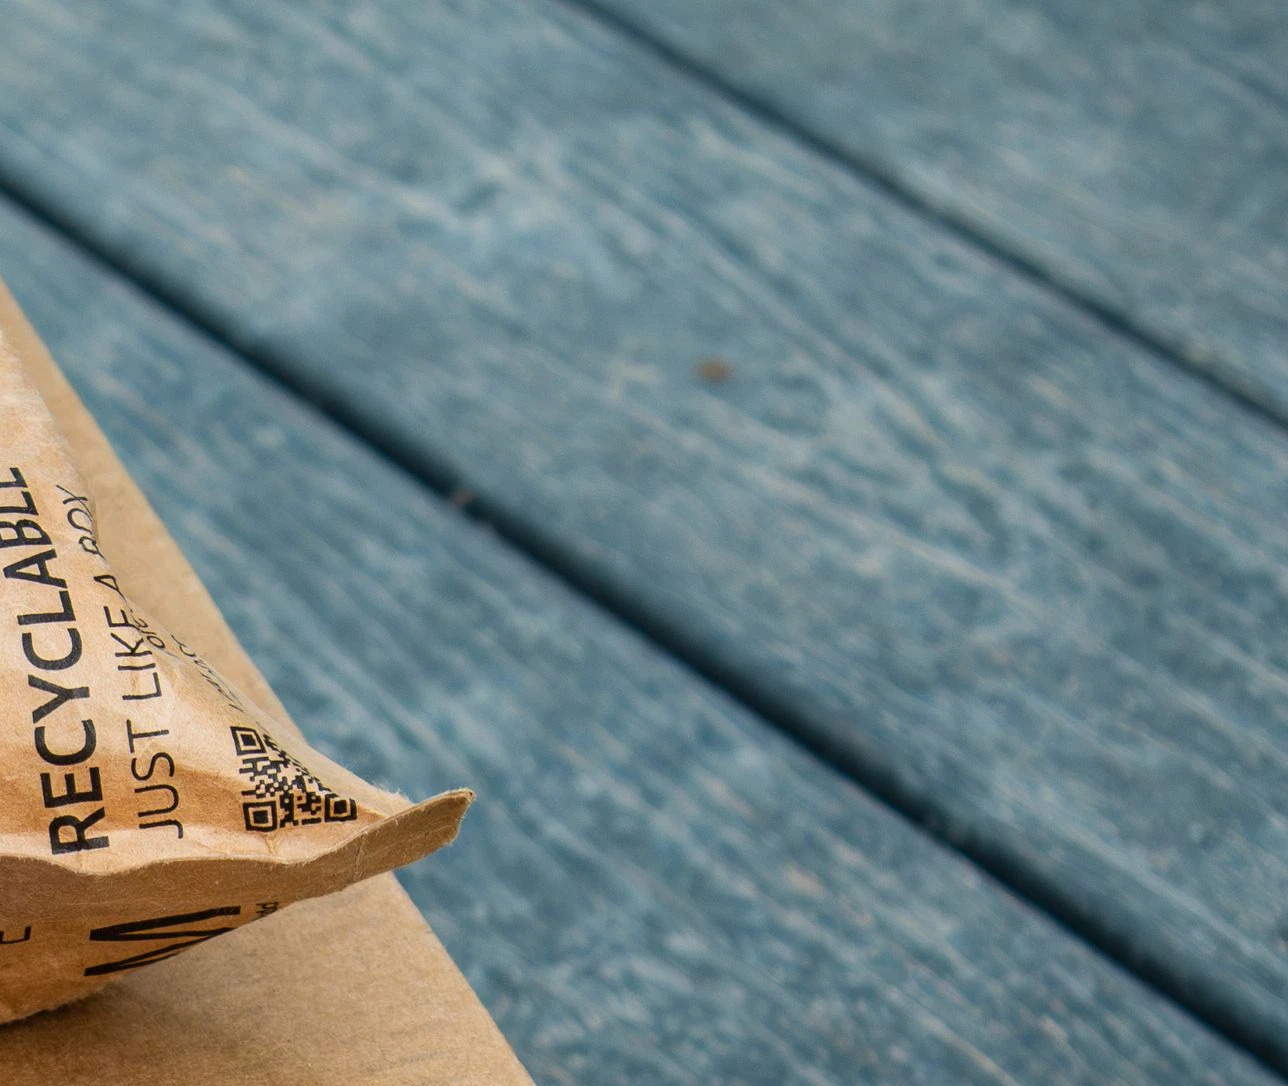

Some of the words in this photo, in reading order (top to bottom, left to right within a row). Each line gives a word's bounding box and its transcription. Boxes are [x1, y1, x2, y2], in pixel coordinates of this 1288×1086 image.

[56, 484, 106, 561] BOX
[104, 606, 163, 701] LIKE
[129, 720, 185, 840] JUST
